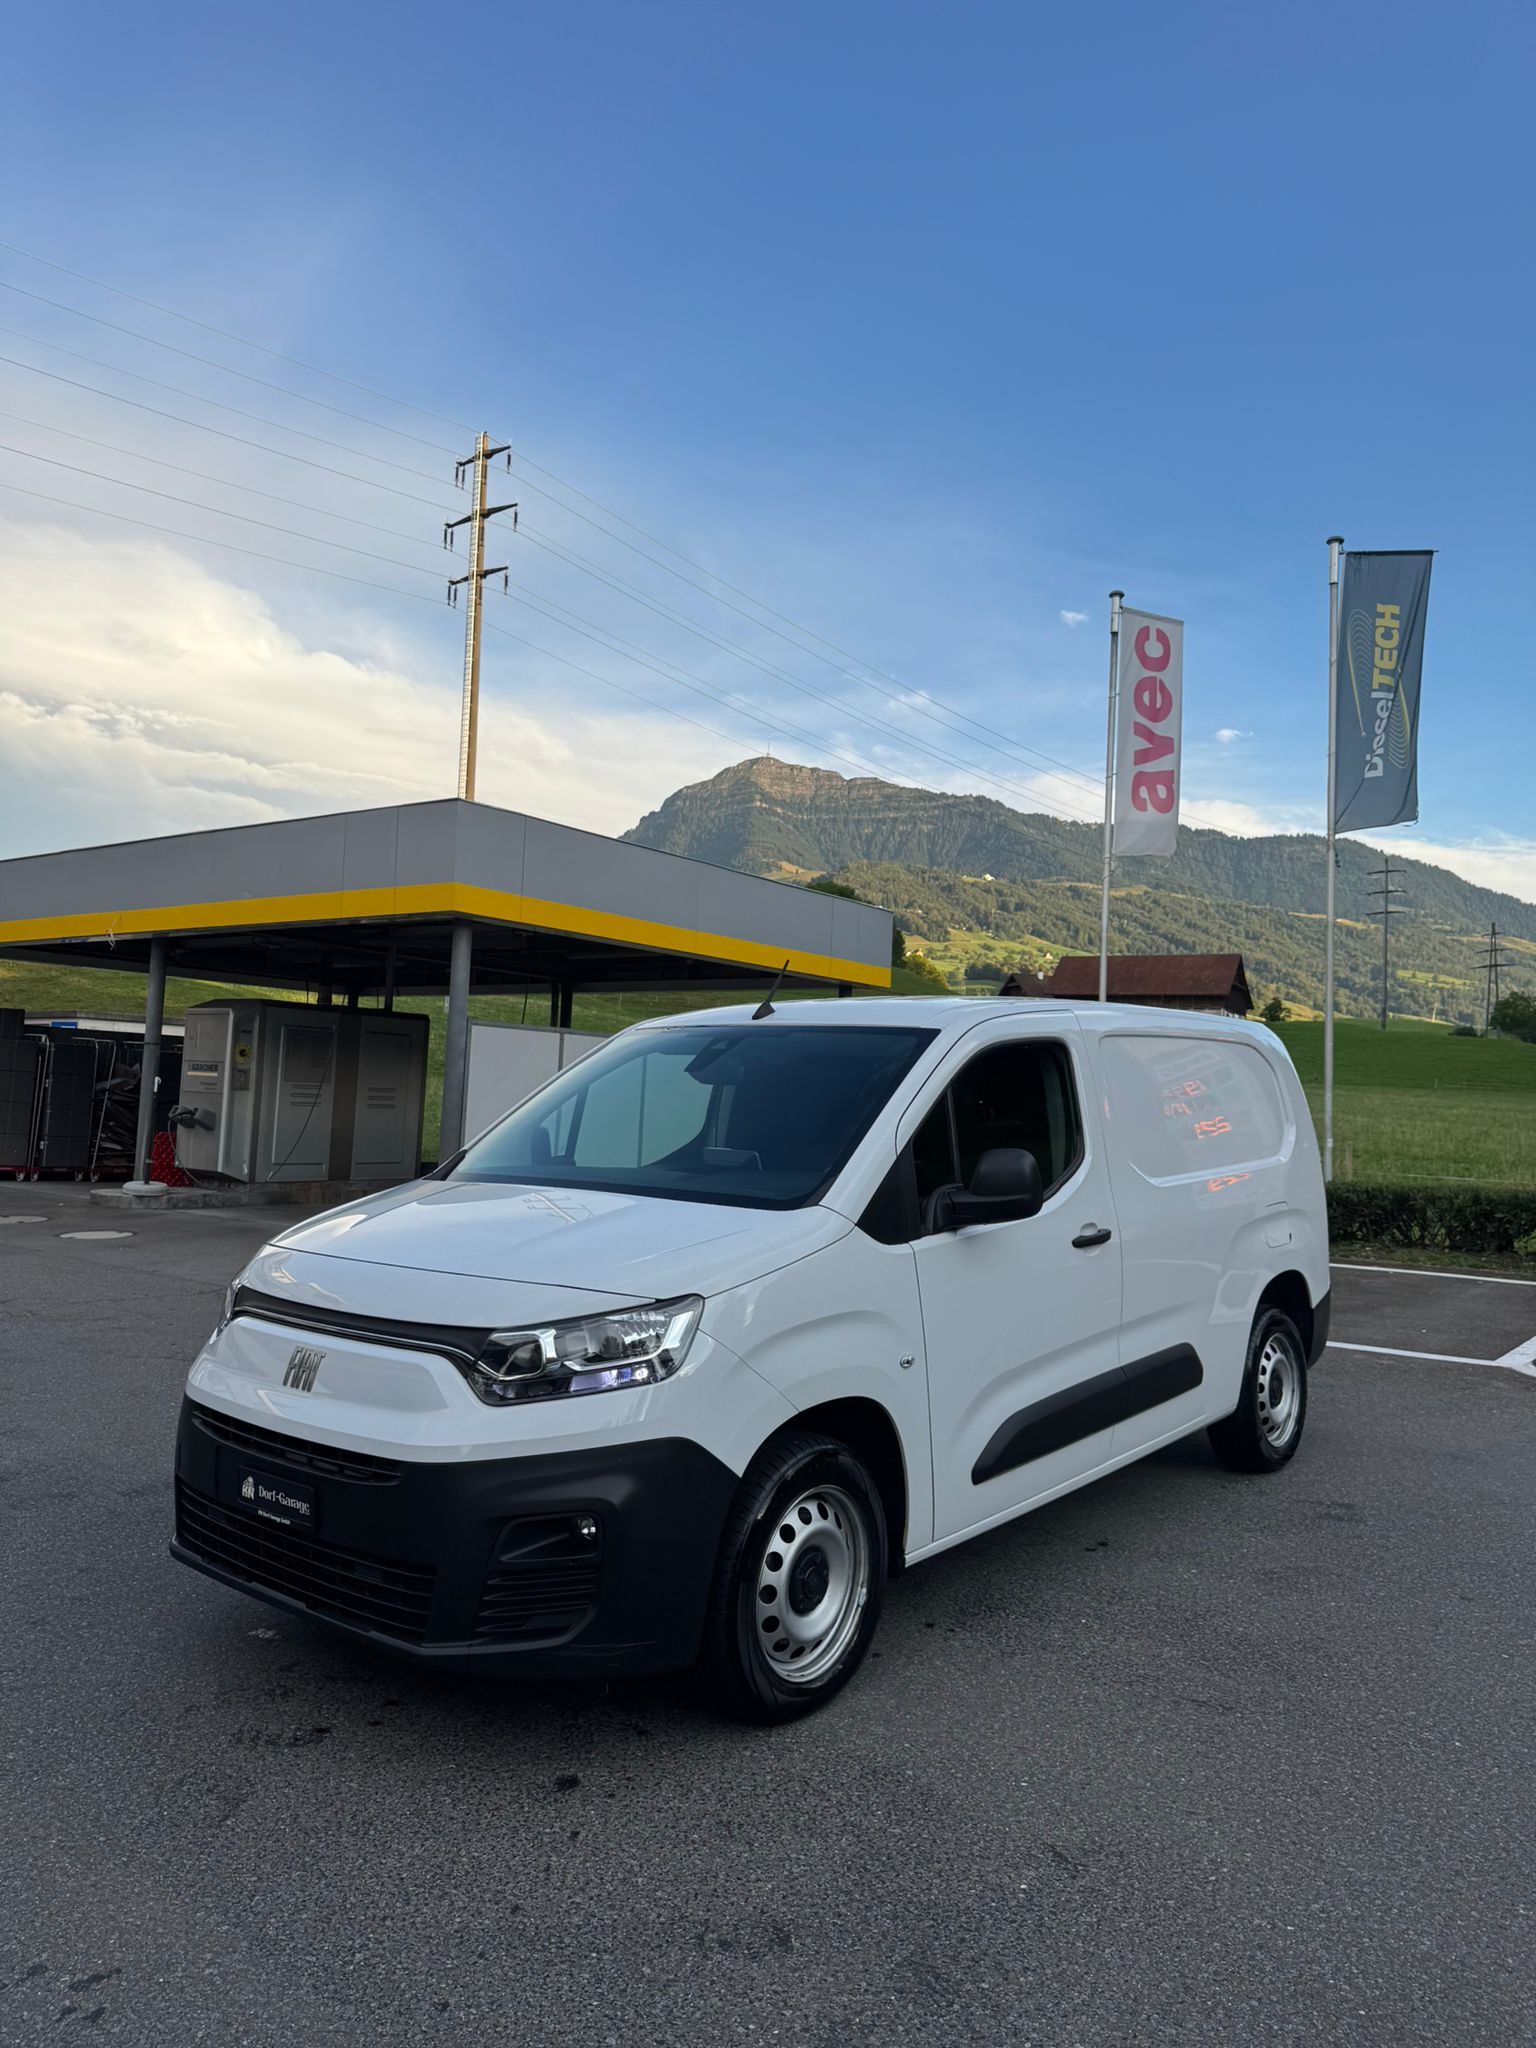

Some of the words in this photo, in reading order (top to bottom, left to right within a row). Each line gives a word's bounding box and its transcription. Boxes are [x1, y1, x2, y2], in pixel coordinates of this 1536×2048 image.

[1131, 625, 1175, 814] avec
[1364, 603, 1401, 778] DieselTECH
[282, 1345, 327, 1393] FIAT
[258, 1485, 310, 1514] Dorf-Garage
